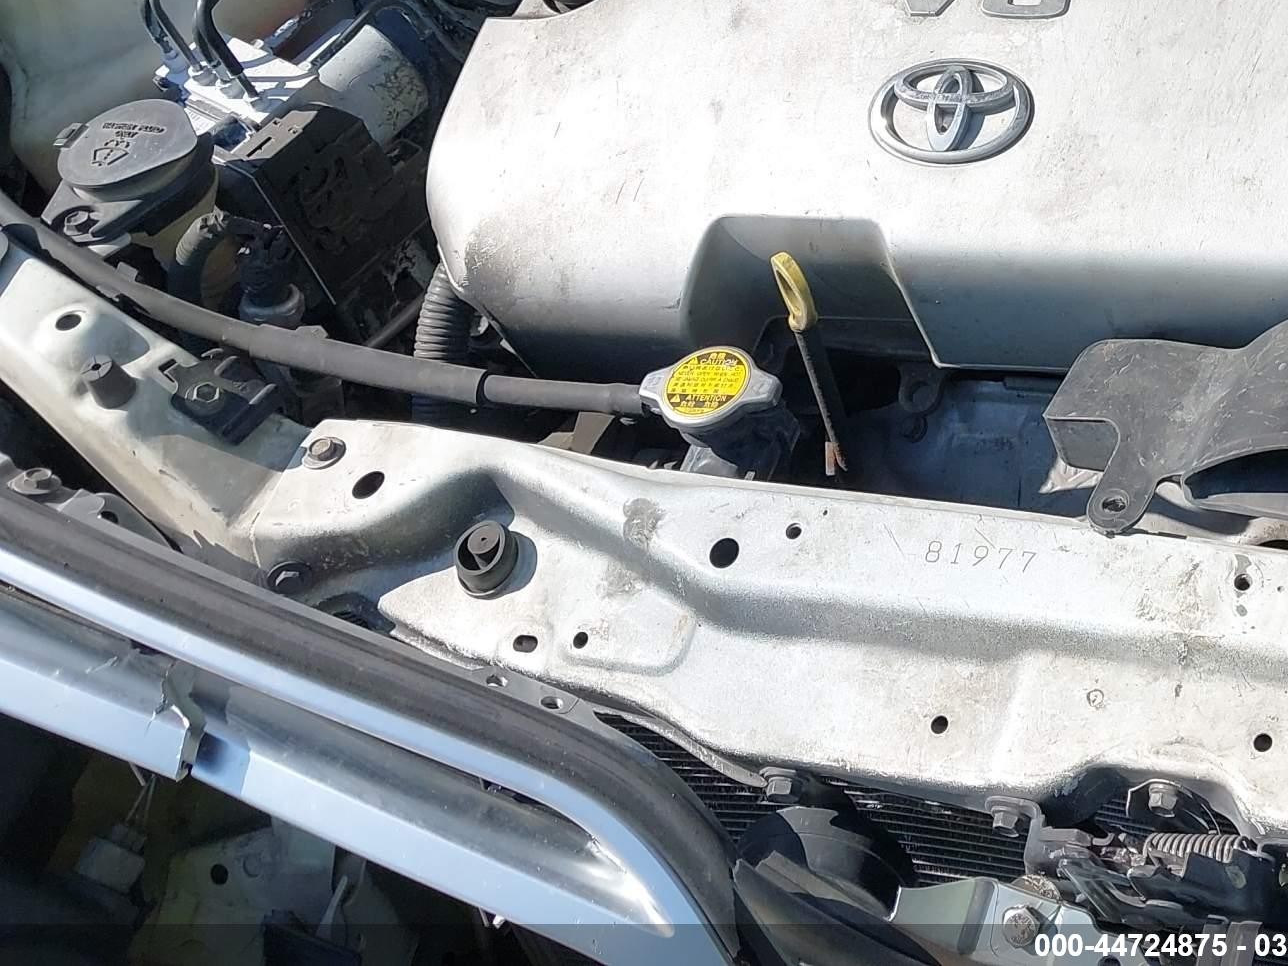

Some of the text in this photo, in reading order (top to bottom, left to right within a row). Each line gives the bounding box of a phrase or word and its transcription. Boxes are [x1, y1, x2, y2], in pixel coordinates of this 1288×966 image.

[700, 358, 738, 366] CAUTION
[685, 394, 727, 402] ATTENTION
[925, 540, 1037, 573] 81977
